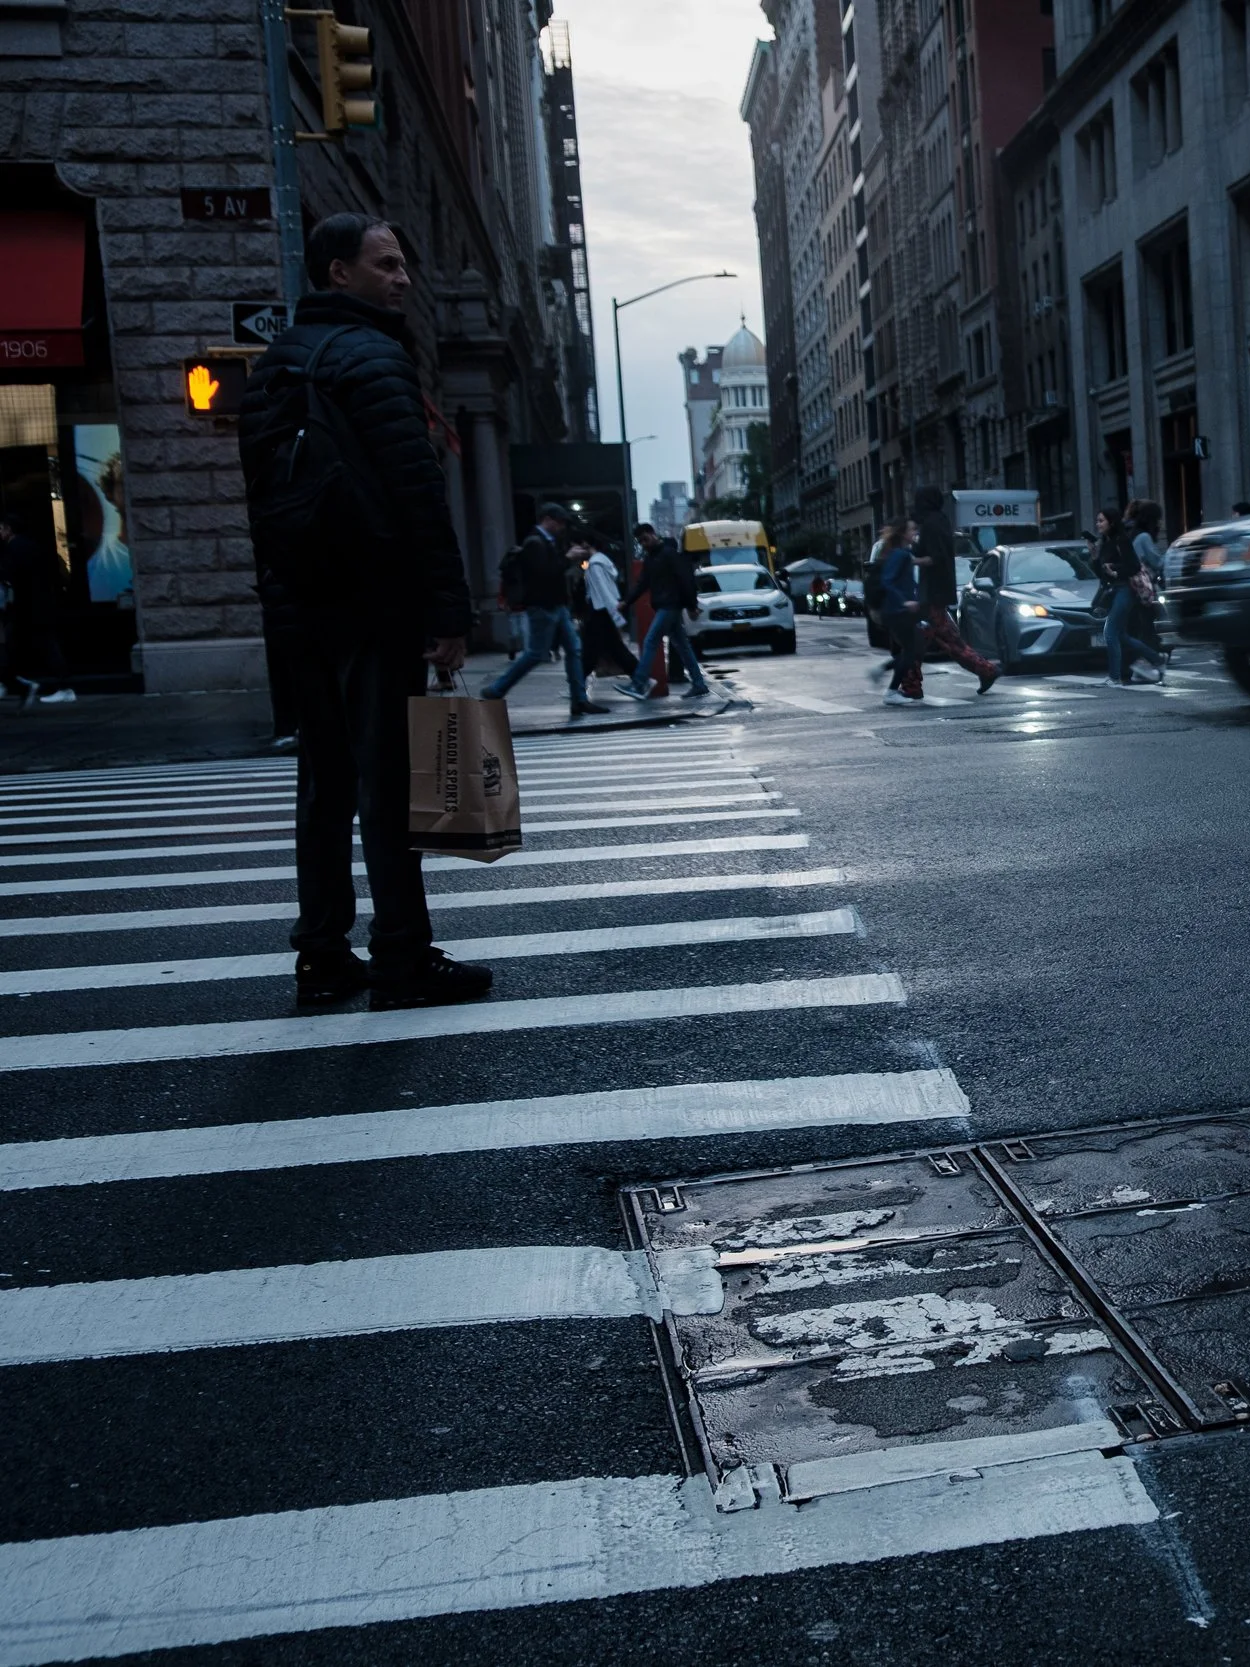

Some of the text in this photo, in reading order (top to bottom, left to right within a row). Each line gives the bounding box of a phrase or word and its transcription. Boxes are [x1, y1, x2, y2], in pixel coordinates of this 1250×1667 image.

[204, 196, 247, 216] 5 Av
[255, 316, 288, 333] ONE
[0, 340, 48, 358] 1906
[975, 504, 1020, 516] GLOBE
[445, 713, 458, 813] PARAGON SPORTS
